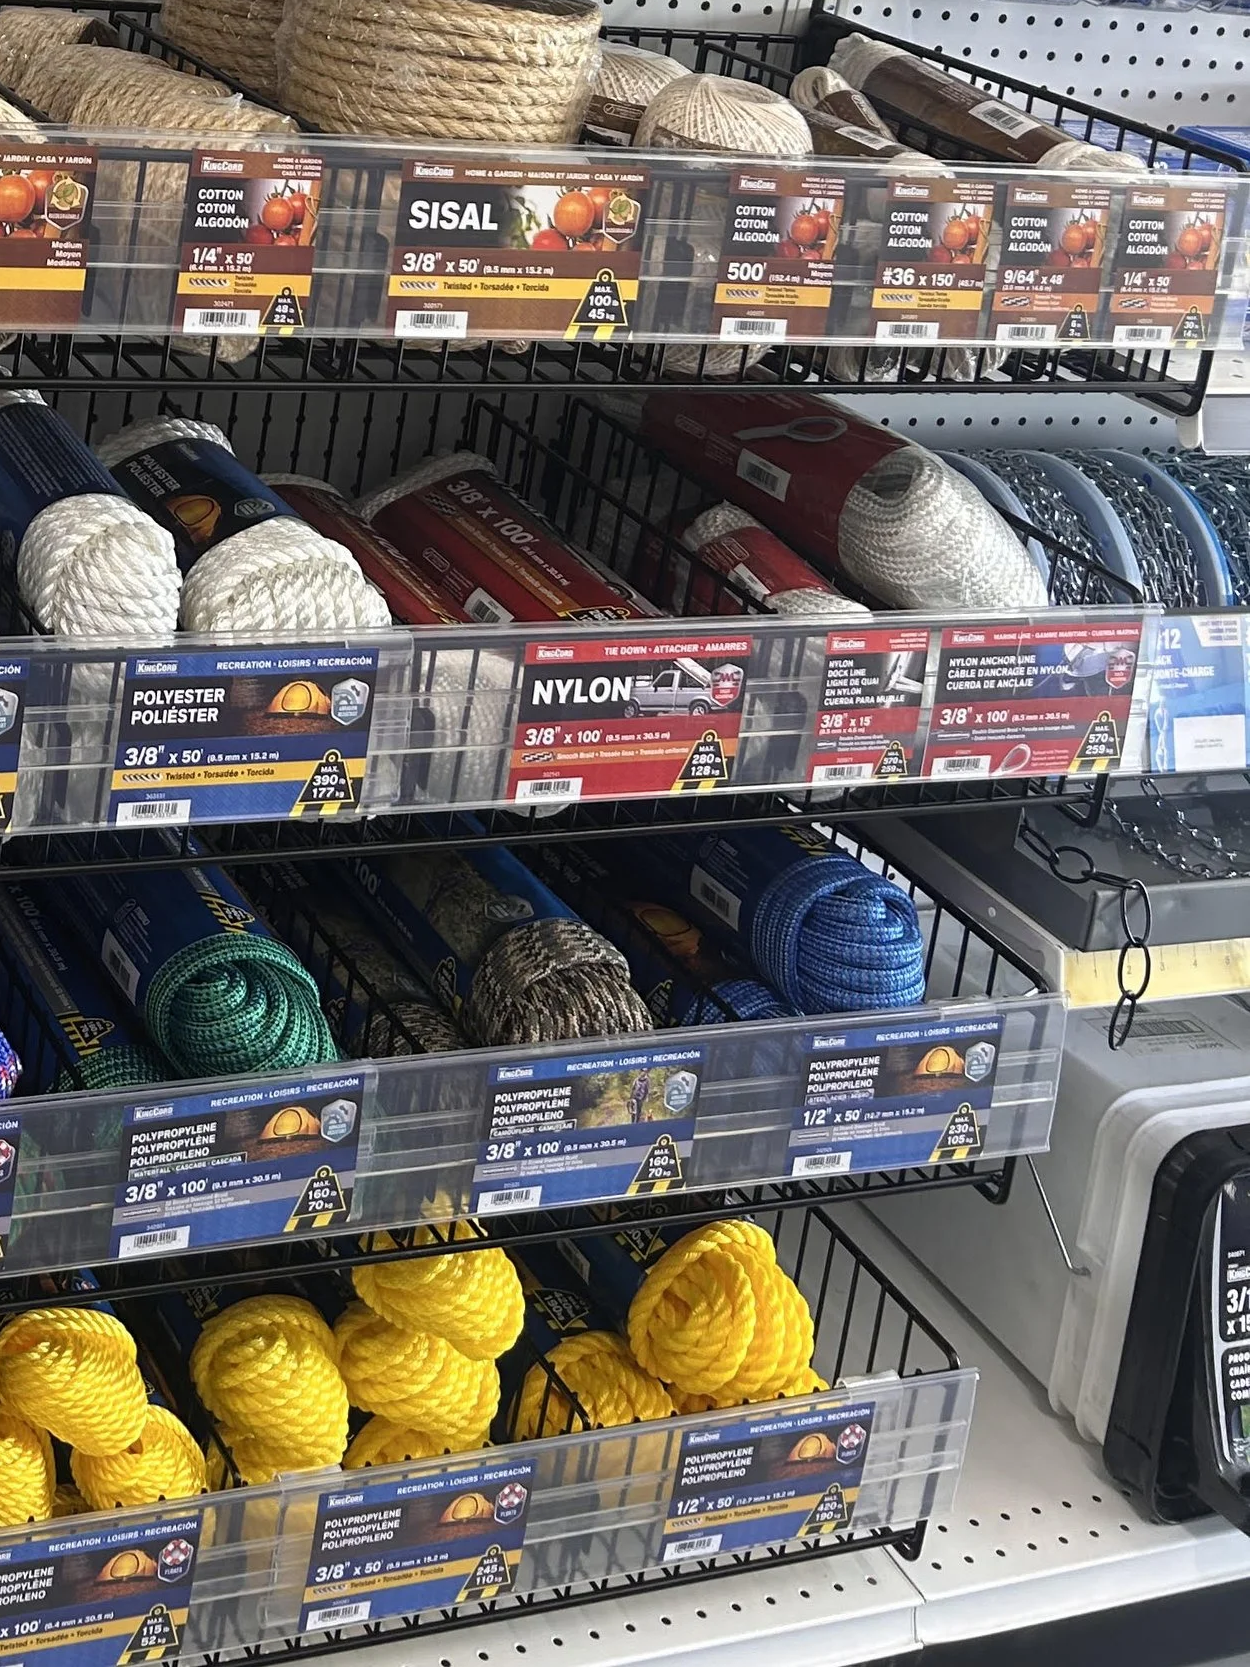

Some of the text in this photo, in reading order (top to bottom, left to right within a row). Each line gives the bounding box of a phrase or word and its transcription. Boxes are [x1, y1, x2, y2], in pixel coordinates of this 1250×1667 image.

[198, 188, 244, 202] COTTON
[197, 202, 236, 215] COTON
[408, 200, 499, 231] SISAL
[194, 214, 250, 230] ALGODÓN
[402, 252, 480, 273] 3/8" x 50'
[727, 263, 767, 282] 500'
[883, 265, 956, 288] #36 x 150'
[604, 642, 747, 655] TIE DOWN ATTACHER AMARRES
[949, 655, 1015, 666] NYLON ANCHOR
[532, 677, 632, 705] NYLON
[494, 1086, 572, 1104] POLYPROPYLENE
[325, 1509, 402, 1529] POLYPROPYLENE
